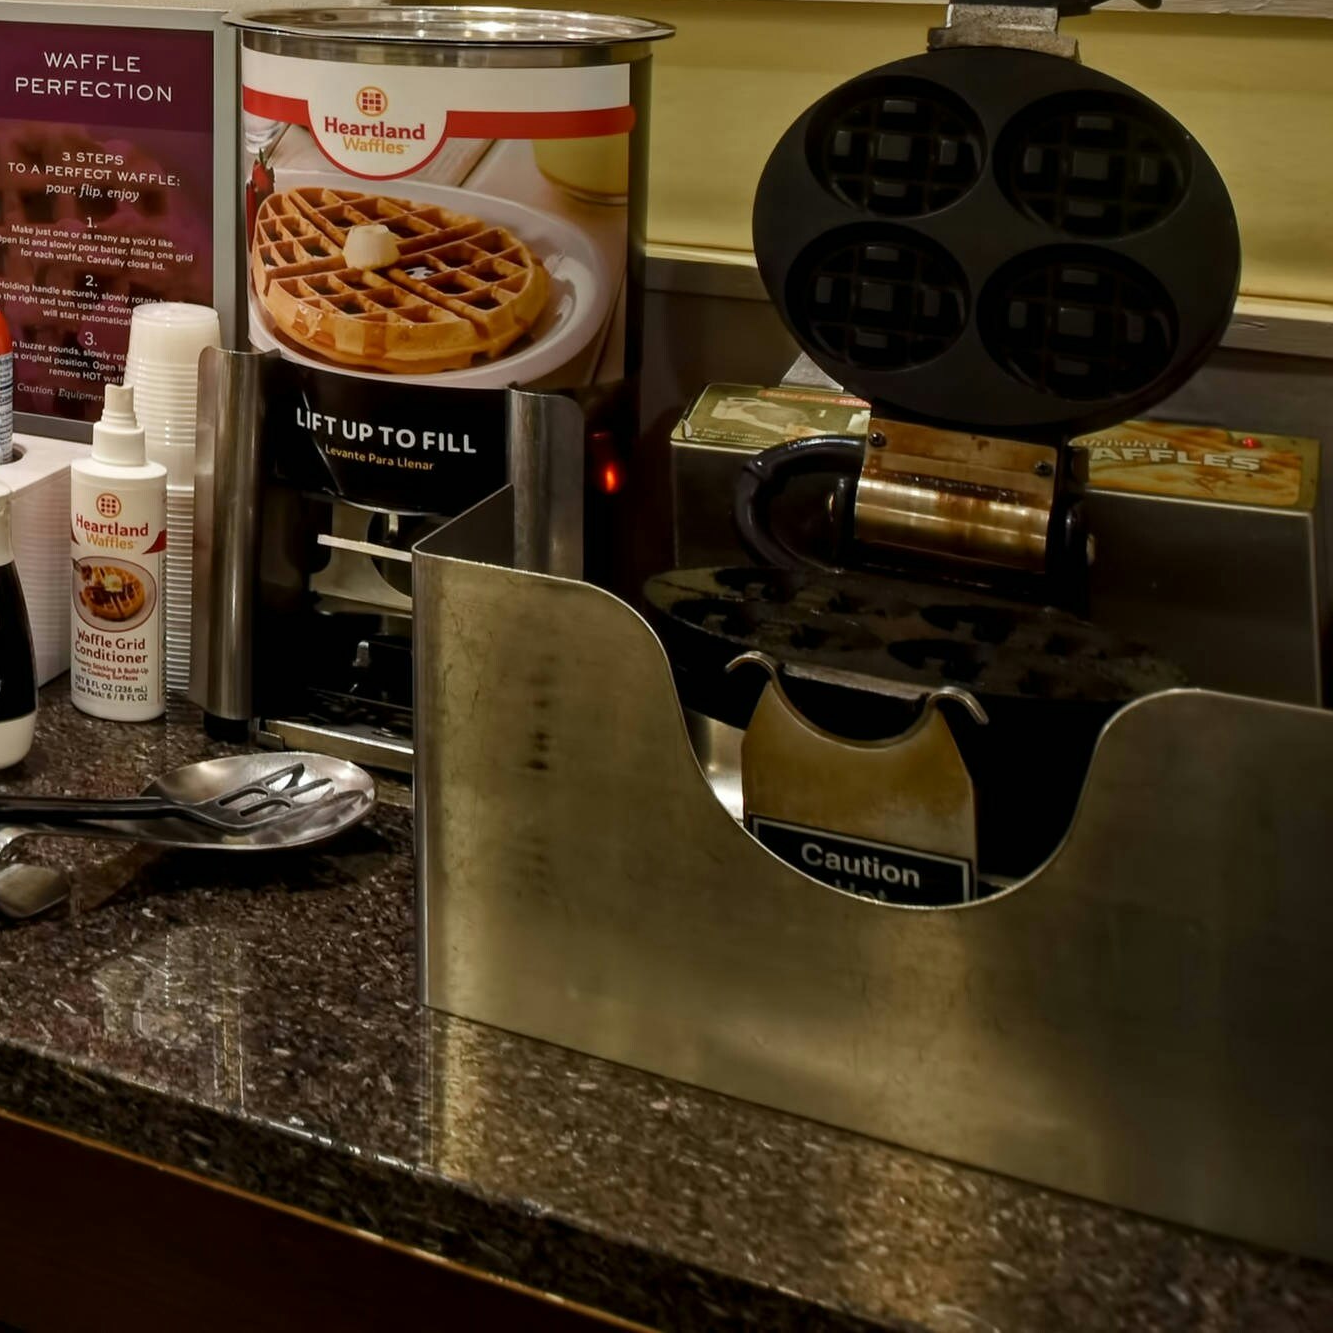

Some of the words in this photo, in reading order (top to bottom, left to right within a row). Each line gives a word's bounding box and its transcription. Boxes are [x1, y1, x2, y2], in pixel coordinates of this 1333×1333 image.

[43, 51, 141, 73] WAFFLE
[15, 76, 172, 103] PERFECTION
[324, 116, 425, 140] Heartland
[343, 136, 404, 155] Waffles
[62, 152, 71, 161] 3
[76, 152, 124, 165] STEPS
[8, 162, 26, 174] TO
[30, 164, 40, 174] A
[45, 165, 112, 180] PERFECT
[116, 171, 180, 186] WAFFLE:
[107, 188, 139, 203] enjoy
[86, 217, 97, 228] 1.
[11, 224, 33, 234] Make
[35, 227, 51, 236] just
[53, 230, 69, 238] one
[71, 231, 80, 239] or
[94, 234, 118, 244] many
[132, 237, 156, 247] you'd
[19, 236, 30, 245] lid
[31, 238, 47, 247] and
[49, 240, 76, 251] slowly
[78, 243, 98, 253] pour
[130, 247, 154, 259] filling
[156, 252, 173, 260] one
[175, 253, 193, 263] grid
[21, 248, 32, 257] for
[34, 250, 53, 259] each
[56, 253, 84, 263] waffle.
[86, 255, 125, 268] Carefully
[127, 260, 149, 269] close
[151, 262, 166, 271] lid.
[85, 274, 98, 287] 2.
[3, 293, 17, 301] the
[18, 294, 38, 305] right
[40, 298, 56, 306] and
[57, 299, 75, 308] turn
[77, 302, 106, 312] upside
[32, 284, 60, 295] handle
[101, 292, 129, 303] slowly
[43, 309, 58, 317] will
[59, 311, 79, 320] start
[81, 314, 132, 326] automatical
[84, 331, 97, 346] 3.
[19, 341, 46, 351] buzzer
[83, 350, 110, 360] slowly
[21, 353, 52, 364] original
[93, 361, 115, 372] Open
[48, 368, 81, 378] remove
[82, 372, 101, 381] HOT
[103, 374, 124, 384] waff
[58, 388, 105, 402] Equipmen
[296, 407, 337, 435] LIFT
[342, 419, 373, 442] UP
[378, 426, 416, 448] TO
[422, 431, 477, 454] FILL
[325, 444, 366, 462] Levante
[369, 453, 394, 466] Para
[398, 457, 435, 470] Llenar
[1091, 447, 1260, 471] AFFLES
[76, 514, 149, 537] Heartland
[86, 531, 134, 549] Waffles
[77, 627, 112, 648] Waffle
[115, 638, 145, 650] Grid
[75, 641, 148, 664] Conditioner
[92, 680, 99, 689] FL
[102, 683, 113, 691] OZ
[801, 843, 920, 889] Caution
